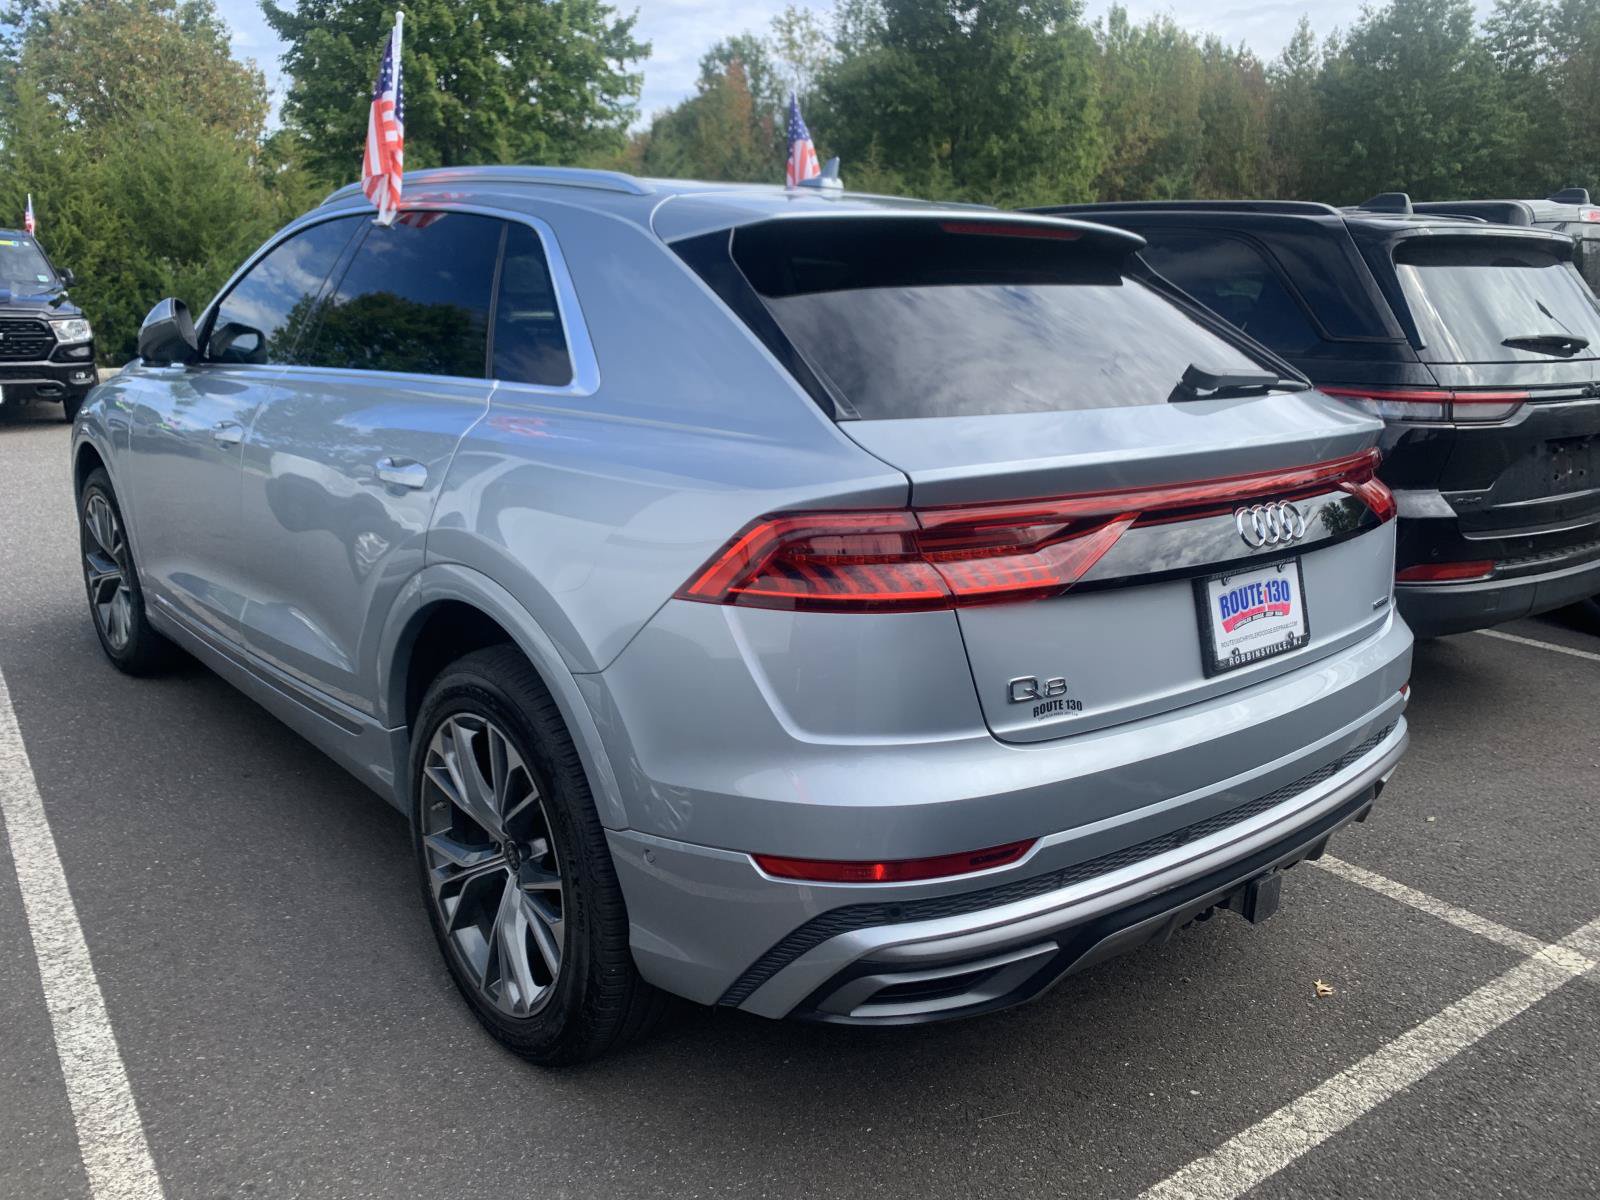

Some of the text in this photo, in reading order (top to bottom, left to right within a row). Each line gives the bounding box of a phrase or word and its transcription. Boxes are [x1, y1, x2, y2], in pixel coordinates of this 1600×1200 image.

[1219, 580, 1290, 620] ROUTE 130
[1229, 638, 1302, 666] ROBBINSVILLE, NJ
[1007, 675, 1067, 704] Q8
[1033, 700, 1063, 718] ROUTE
[1066, 699, 1083, 711] 130
